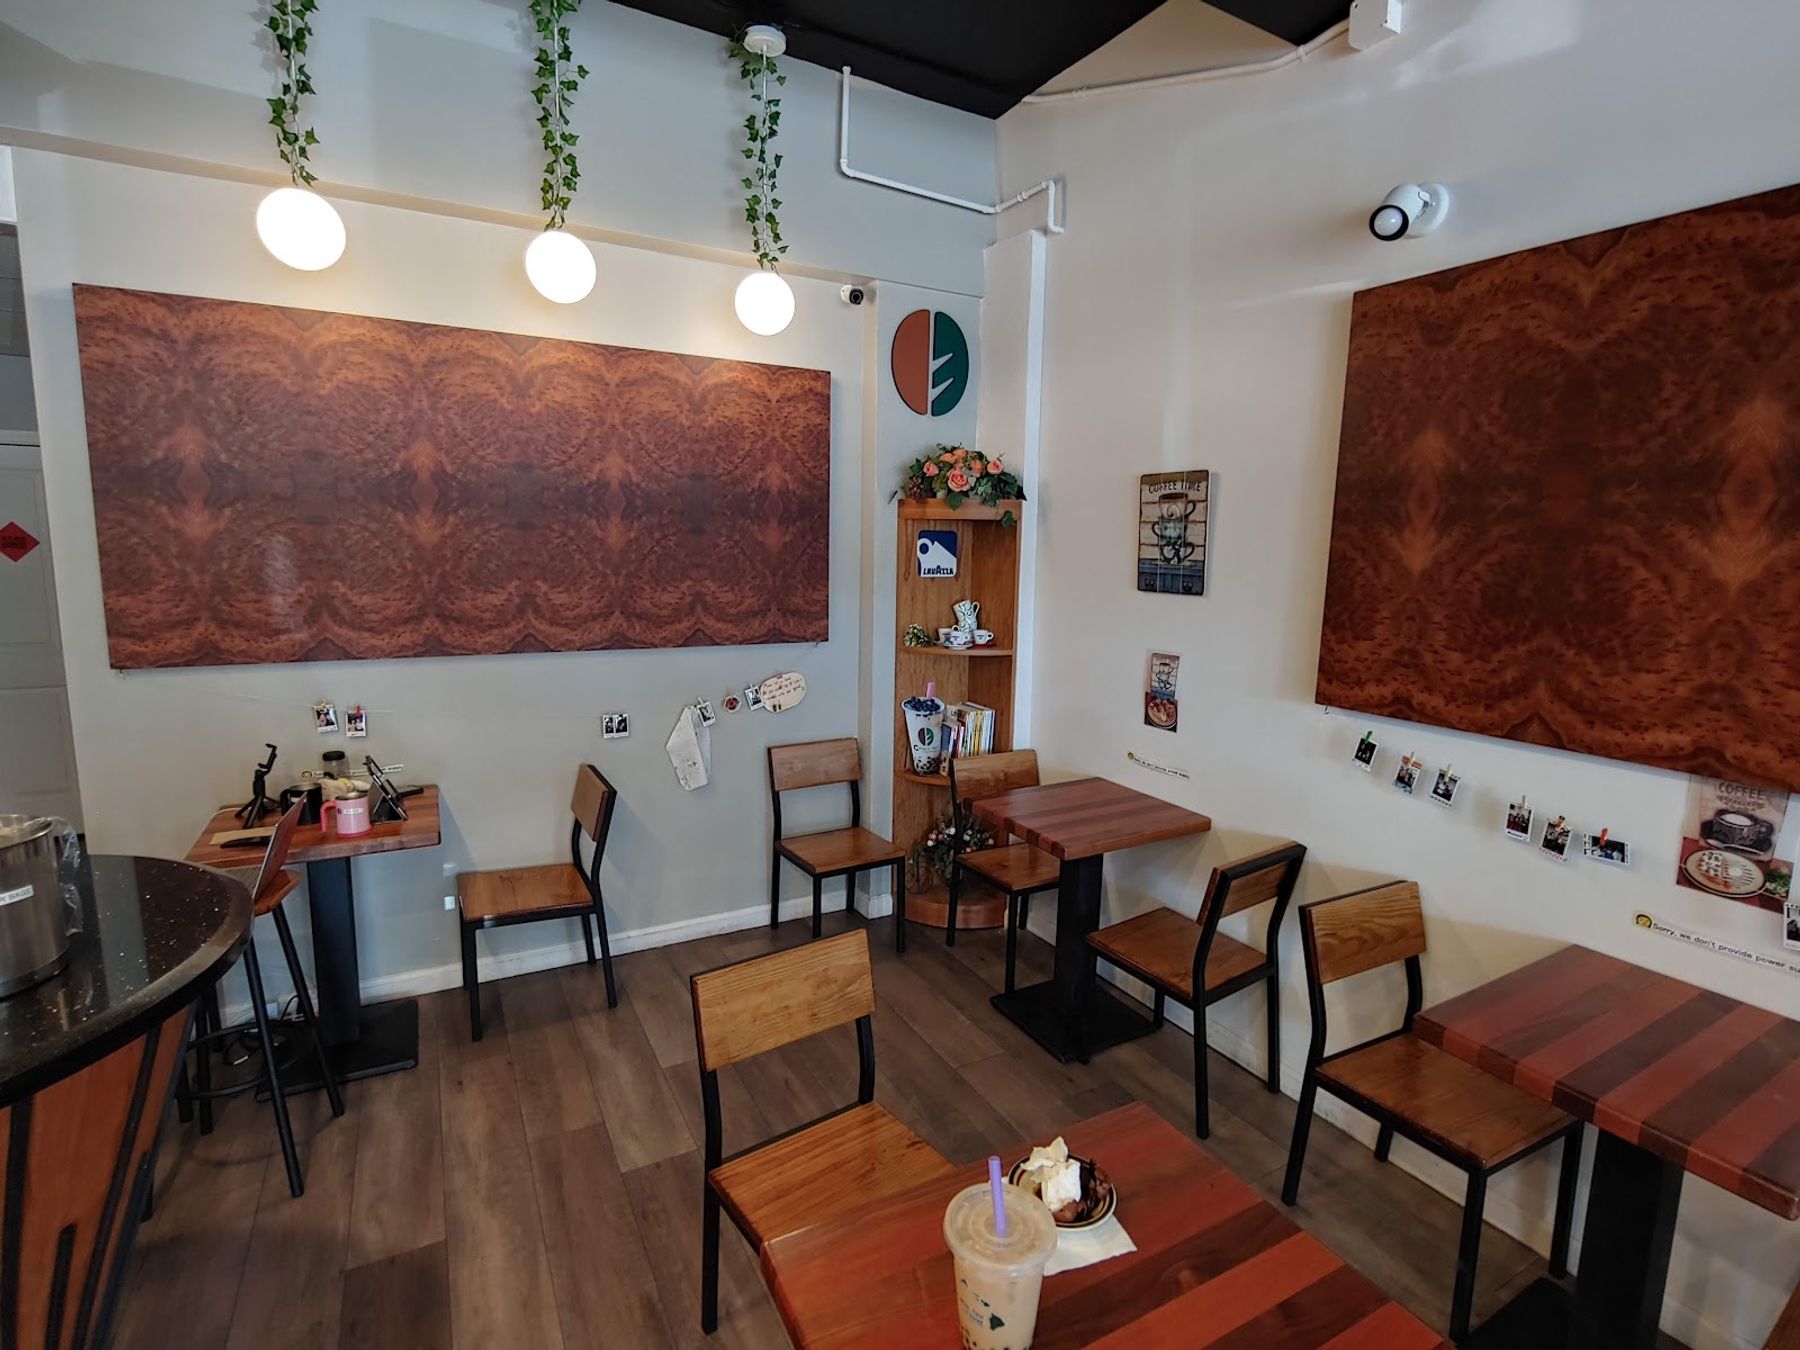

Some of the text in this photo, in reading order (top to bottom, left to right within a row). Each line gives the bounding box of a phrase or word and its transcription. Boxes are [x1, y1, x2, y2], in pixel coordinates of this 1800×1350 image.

[1149, 480, 1202, 494] COFFEE TIME
[923, 565, 954, 575] LAVAZZA
[1718, 781, 1767, 801] COFFEE
[1653, 923, 1677, 936] Sorry,
[1680, 932, 1691, 940] we
[1694, 937, 1715, 948] don't
[1718, 944, 1752, 959] provide
[1755, 955, 1785, 968] power
